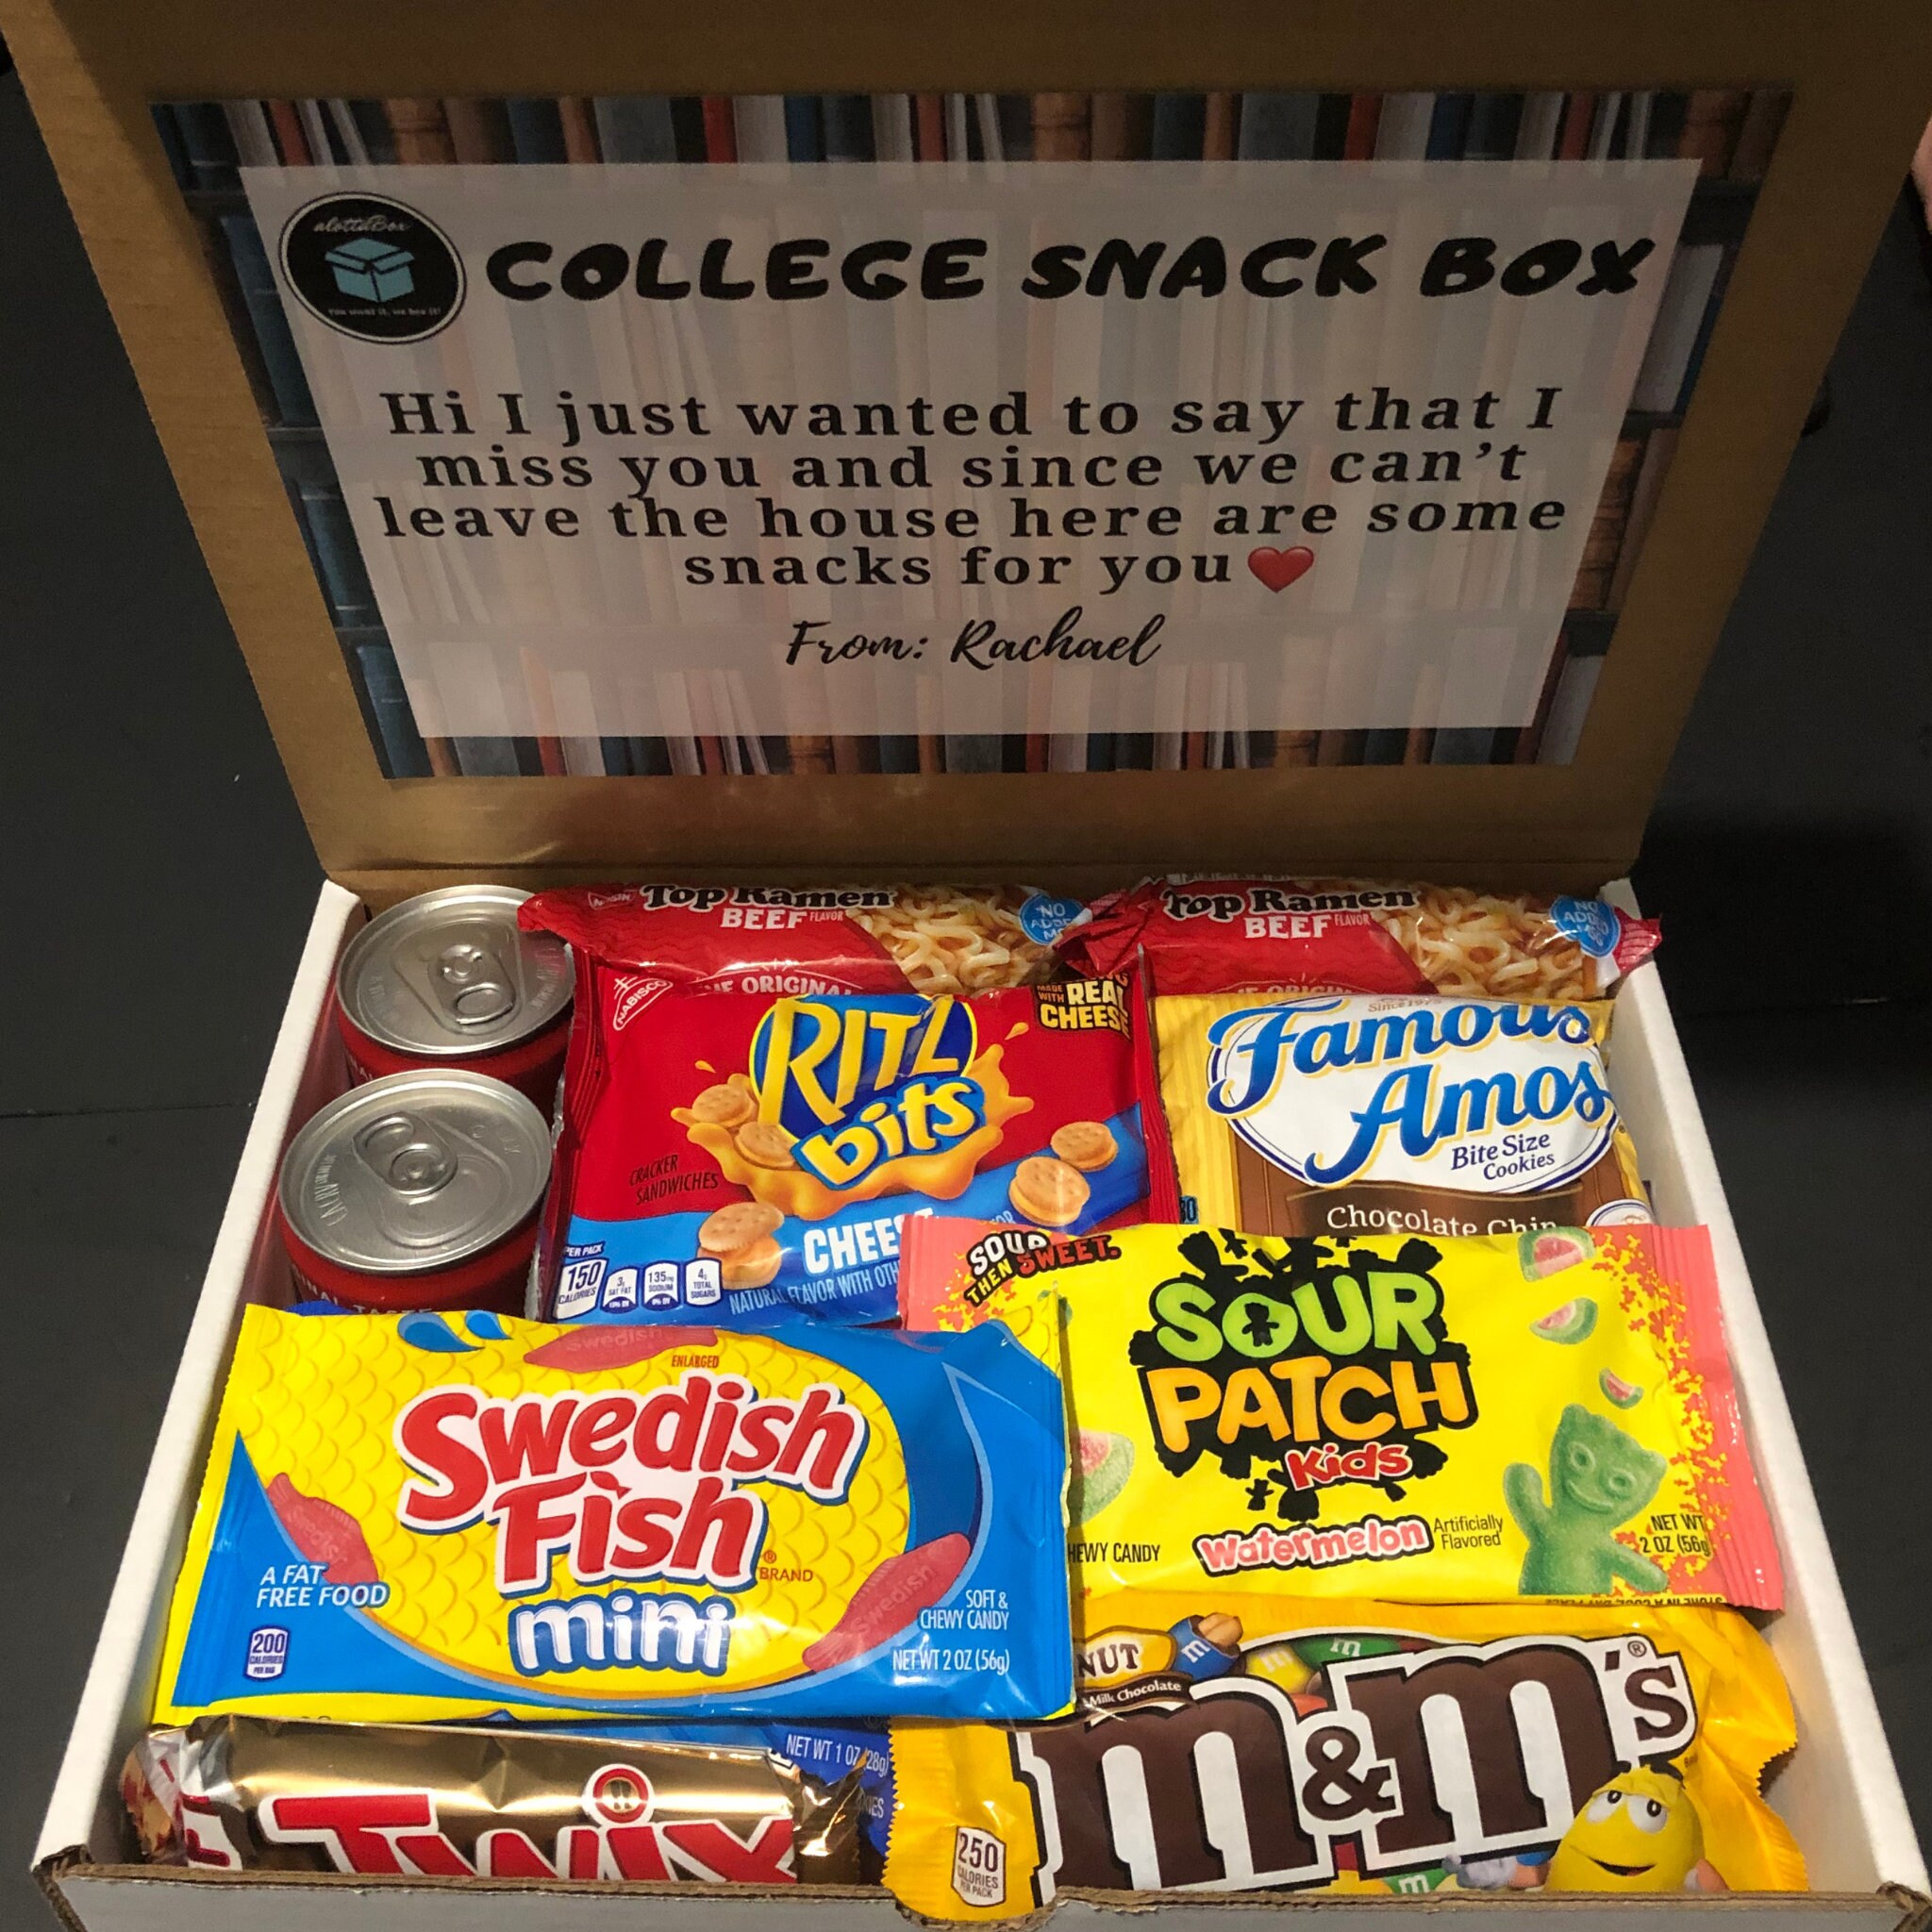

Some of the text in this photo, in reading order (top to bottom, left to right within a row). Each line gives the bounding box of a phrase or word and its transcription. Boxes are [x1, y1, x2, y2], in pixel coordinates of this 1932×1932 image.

[486, 235, 1656, 301] COLLEGE SNACK BOX
[379, 387, 1563, 447] Hi I just wanted to say that I
[416, 444, 594, 489] miss
[619, 454, 761, 499] you
[791, 447, 930, 489] and
[962, 446, 1163, 489] since
[1193, 451, 1299, 486] we
[374, 496, 1566, 539] leave the house here are some
[685, 545, 1232, 595] snacks for you
[785, 605, 1167, 672] From: Rachael
[639, 884, 728, 911] Top
[729, 886, 897, 910] Ramen
[1038, 902, 1066, 918] NO
[1160, 887, 1420, 923] Top Ramen
[1574, 900, 1599, 912] NO
[720, 908, 844, 930] BEEF FLAVOR
[1031, 917, 1073, 930] ADDE
[1244, 913, 1369, 940] BEEF FLAVOR
[741, 974, 852, 996] ORIGINA
[1039, 991, 1065, 1004] WITH
[1066, 979, 1128, 1018] REAL
[616, 978, 670, 1025] NABISCO
[1368, 1000, 1406, 1013] Since
[1040, 1003, 1131, 1040] CHEESE
[758, 995, 961, 1126] RITZ
[1208, 998, 1592, 1116] Famous
[804, 1080, 975, 1186] bits
[1305, 1061, 1614, 1184] Amos
[1451, 1133, 1551, 1171] Bite Size
[1483, 1152, 1556, 1181] Cookies
[629, 1154, 678, 1187] CRACKER
[635, 1172, 719, 1206] SANDWICHES
[1325, 1204, 1478, 1237] Chocolate
[565, 1242, 604, 1257] PER PACK
[804, 1207, 934, 1274] CHEE
[567, 1260, 603, 1292] 150
[693, 1281, 712, 1290] TOTAL
[967, 1237, 1121, 1305] THEN SWEET.
[558, 1287, 597, 1306] CALORIES
[691, 1290, 717, 1299] SUGARS
[728, 1260, 901, 1315] NATURAL FLAVOR WITH OTH
[1156, 1270, 1442, 1360] SOUR
[671, 1355, 721, 1369] ENLARGED
[1142, 1357, 1470, 1454] PATCH
[400, 1374, 857, 1523] Swedish
[1286, 1442, 1413, 1492] Kids
[495, 1472, 760, 1585] Fish
[1433, 1514, 1504, 1535] Artificially
[1651, 1513, 1706, 1532] NET WT
[1067, 1541, 1160, 1564] HEWY CANDY
[1198, 1518, 1427, 1574] Watermelon
[1441, 1530, 1502, 1552] Flavored
[1639, 1535, 1711, 1557] 2 OZ (56g
[260, 1564, 326, 1586] A FAT
[758, 1566, 814, 1582] BRAND
[256, 1584, 389, 1608] FREE FOOD
[965, 1590, 1008, 1608] SOFT &
[516, 1594, 731, 1674] mini
[920, 1609, 1009, 1630] CHEWY CANDY
[252, 1633, 284, 1654] 200
[248, 1655, 284, 1665] CALORIES
[892, 1649, 1010, 1676] NET WT 2 OZ (56g)
[1076, 1642, 1140, 1678] NUT
[1116, 1679, 1182, 1702] Chocolate
[786, 1733, 812, 1758] NET
[812, 1738, 834, 1762] WT
[836, 1742, 842, 1764] 1
[862, 1750, 890, 1778] 28g)
[958, 1832, 999, 1873] 250
[957, 1864, 1000, 1890] CALORIES
[972, 1883, 993, 1898] PACK
